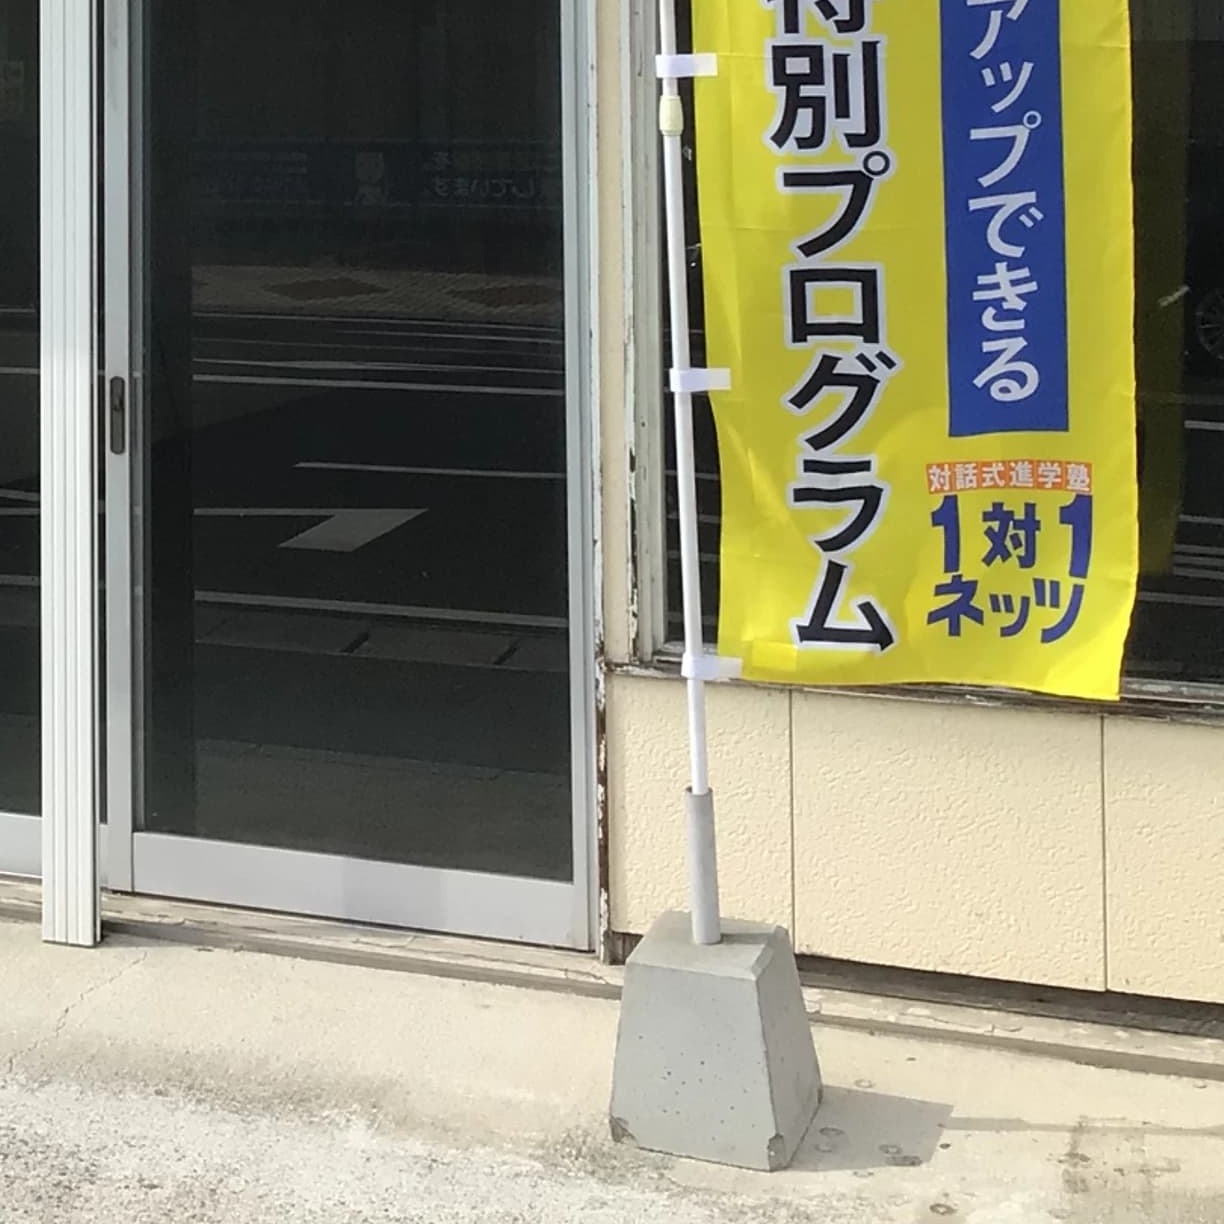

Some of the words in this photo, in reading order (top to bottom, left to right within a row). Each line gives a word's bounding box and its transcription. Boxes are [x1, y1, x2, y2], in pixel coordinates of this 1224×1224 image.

[928, 461, 1090, 492] 対話式進学塾
[930, 494, 1093, 579] 1対1
[927, 574, 1085, 643] ネッツ
